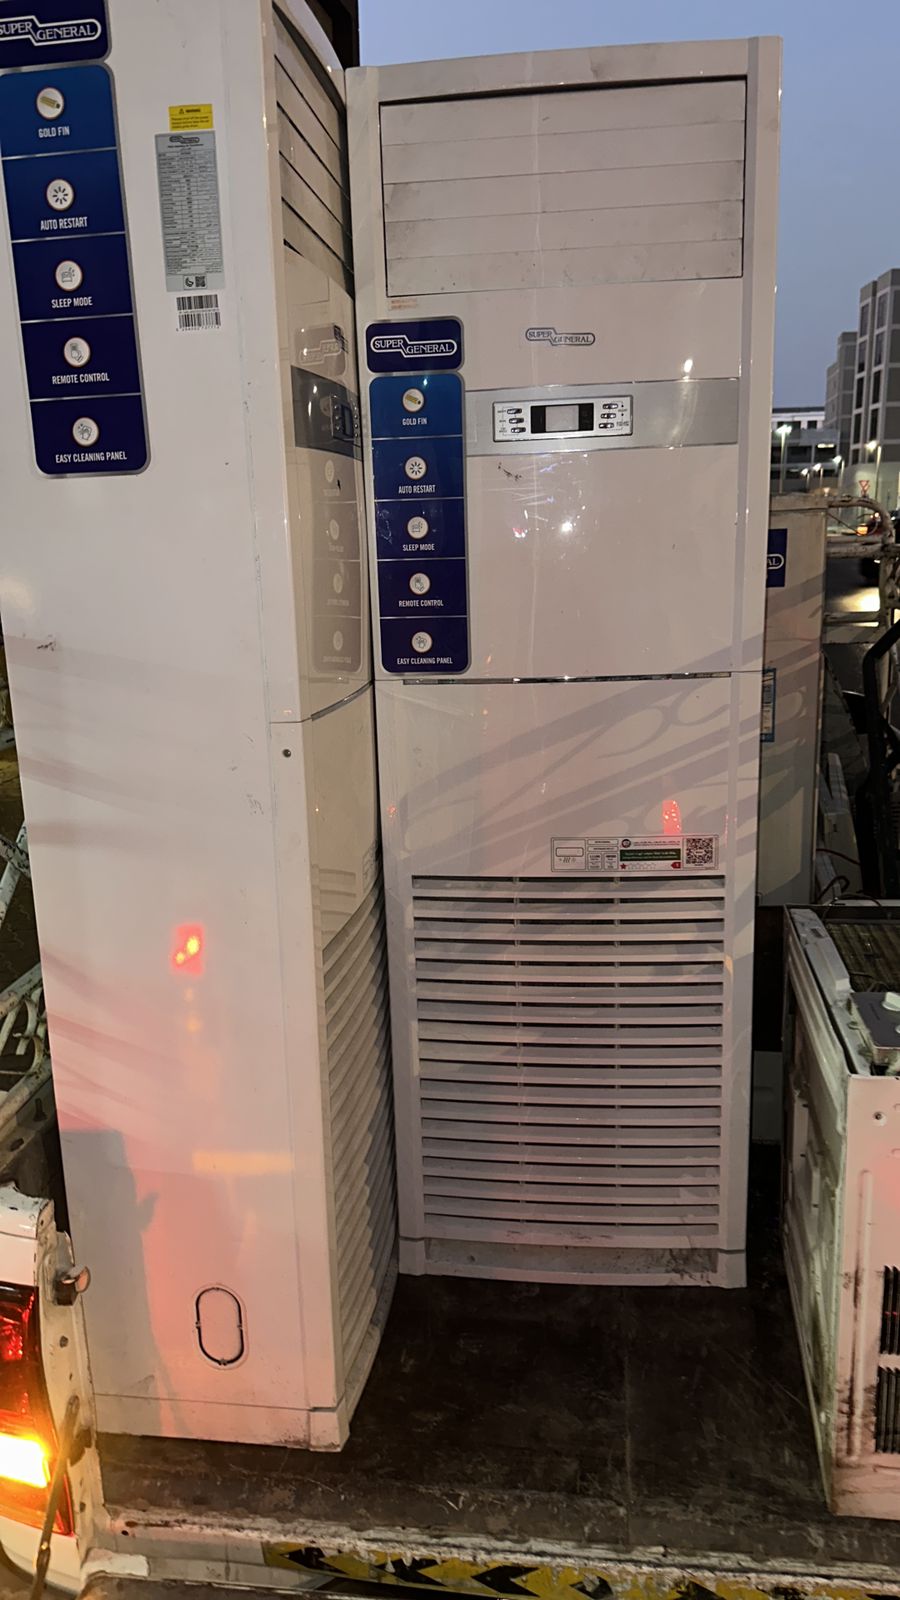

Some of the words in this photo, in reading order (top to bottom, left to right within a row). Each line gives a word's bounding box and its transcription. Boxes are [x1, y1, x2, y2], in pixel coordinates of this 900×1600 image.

[36, 24, 95, 41] GENERAL
[38, 127, 56, 138] GOLD
[58, 126, 70, 137] FIN
[40, 219, 57, 231] AUTO
[58, 216, 88, 230] RESTART
[52, 298, 73, 308] SLEEP
[74, 297, 92, 307] MODE
[374, 339, 404, 349] SUPER
[406, 345, 453, 354] GENERAL
[52, 375, 79, 385] REMOTE
[80, 373, 109, 383] CONTROL
[56, 454, 72, 463] EASY
[73, 452, 105, 463] CLEANING
[106, 451, 127, 461] PANEL
[413, 484, 436, 493] RESTART
